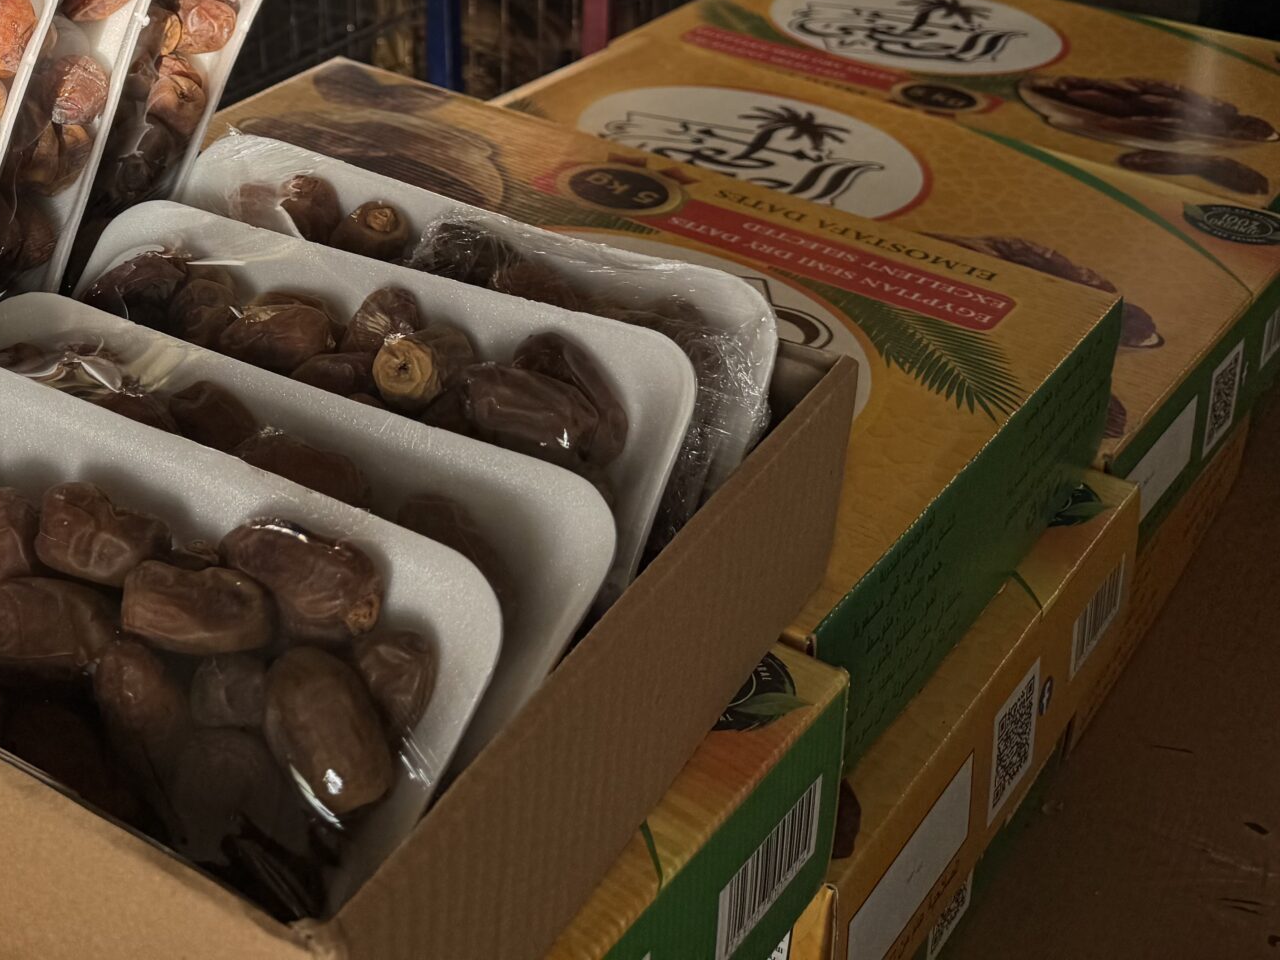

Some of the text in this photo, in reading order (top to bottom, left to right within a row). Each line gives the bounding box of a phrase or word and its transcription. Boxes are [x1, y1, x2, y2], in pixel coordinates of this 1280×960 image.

[586, 172, 660, 205] 5 kg
[669, 214, 992, 323] EGYPTIAN SEMI DRY DATES
[719, 189, 998, 282] ELMOSTAFA DATES
[742, 221, 1008, 310] EXCELLENT SELECTED
